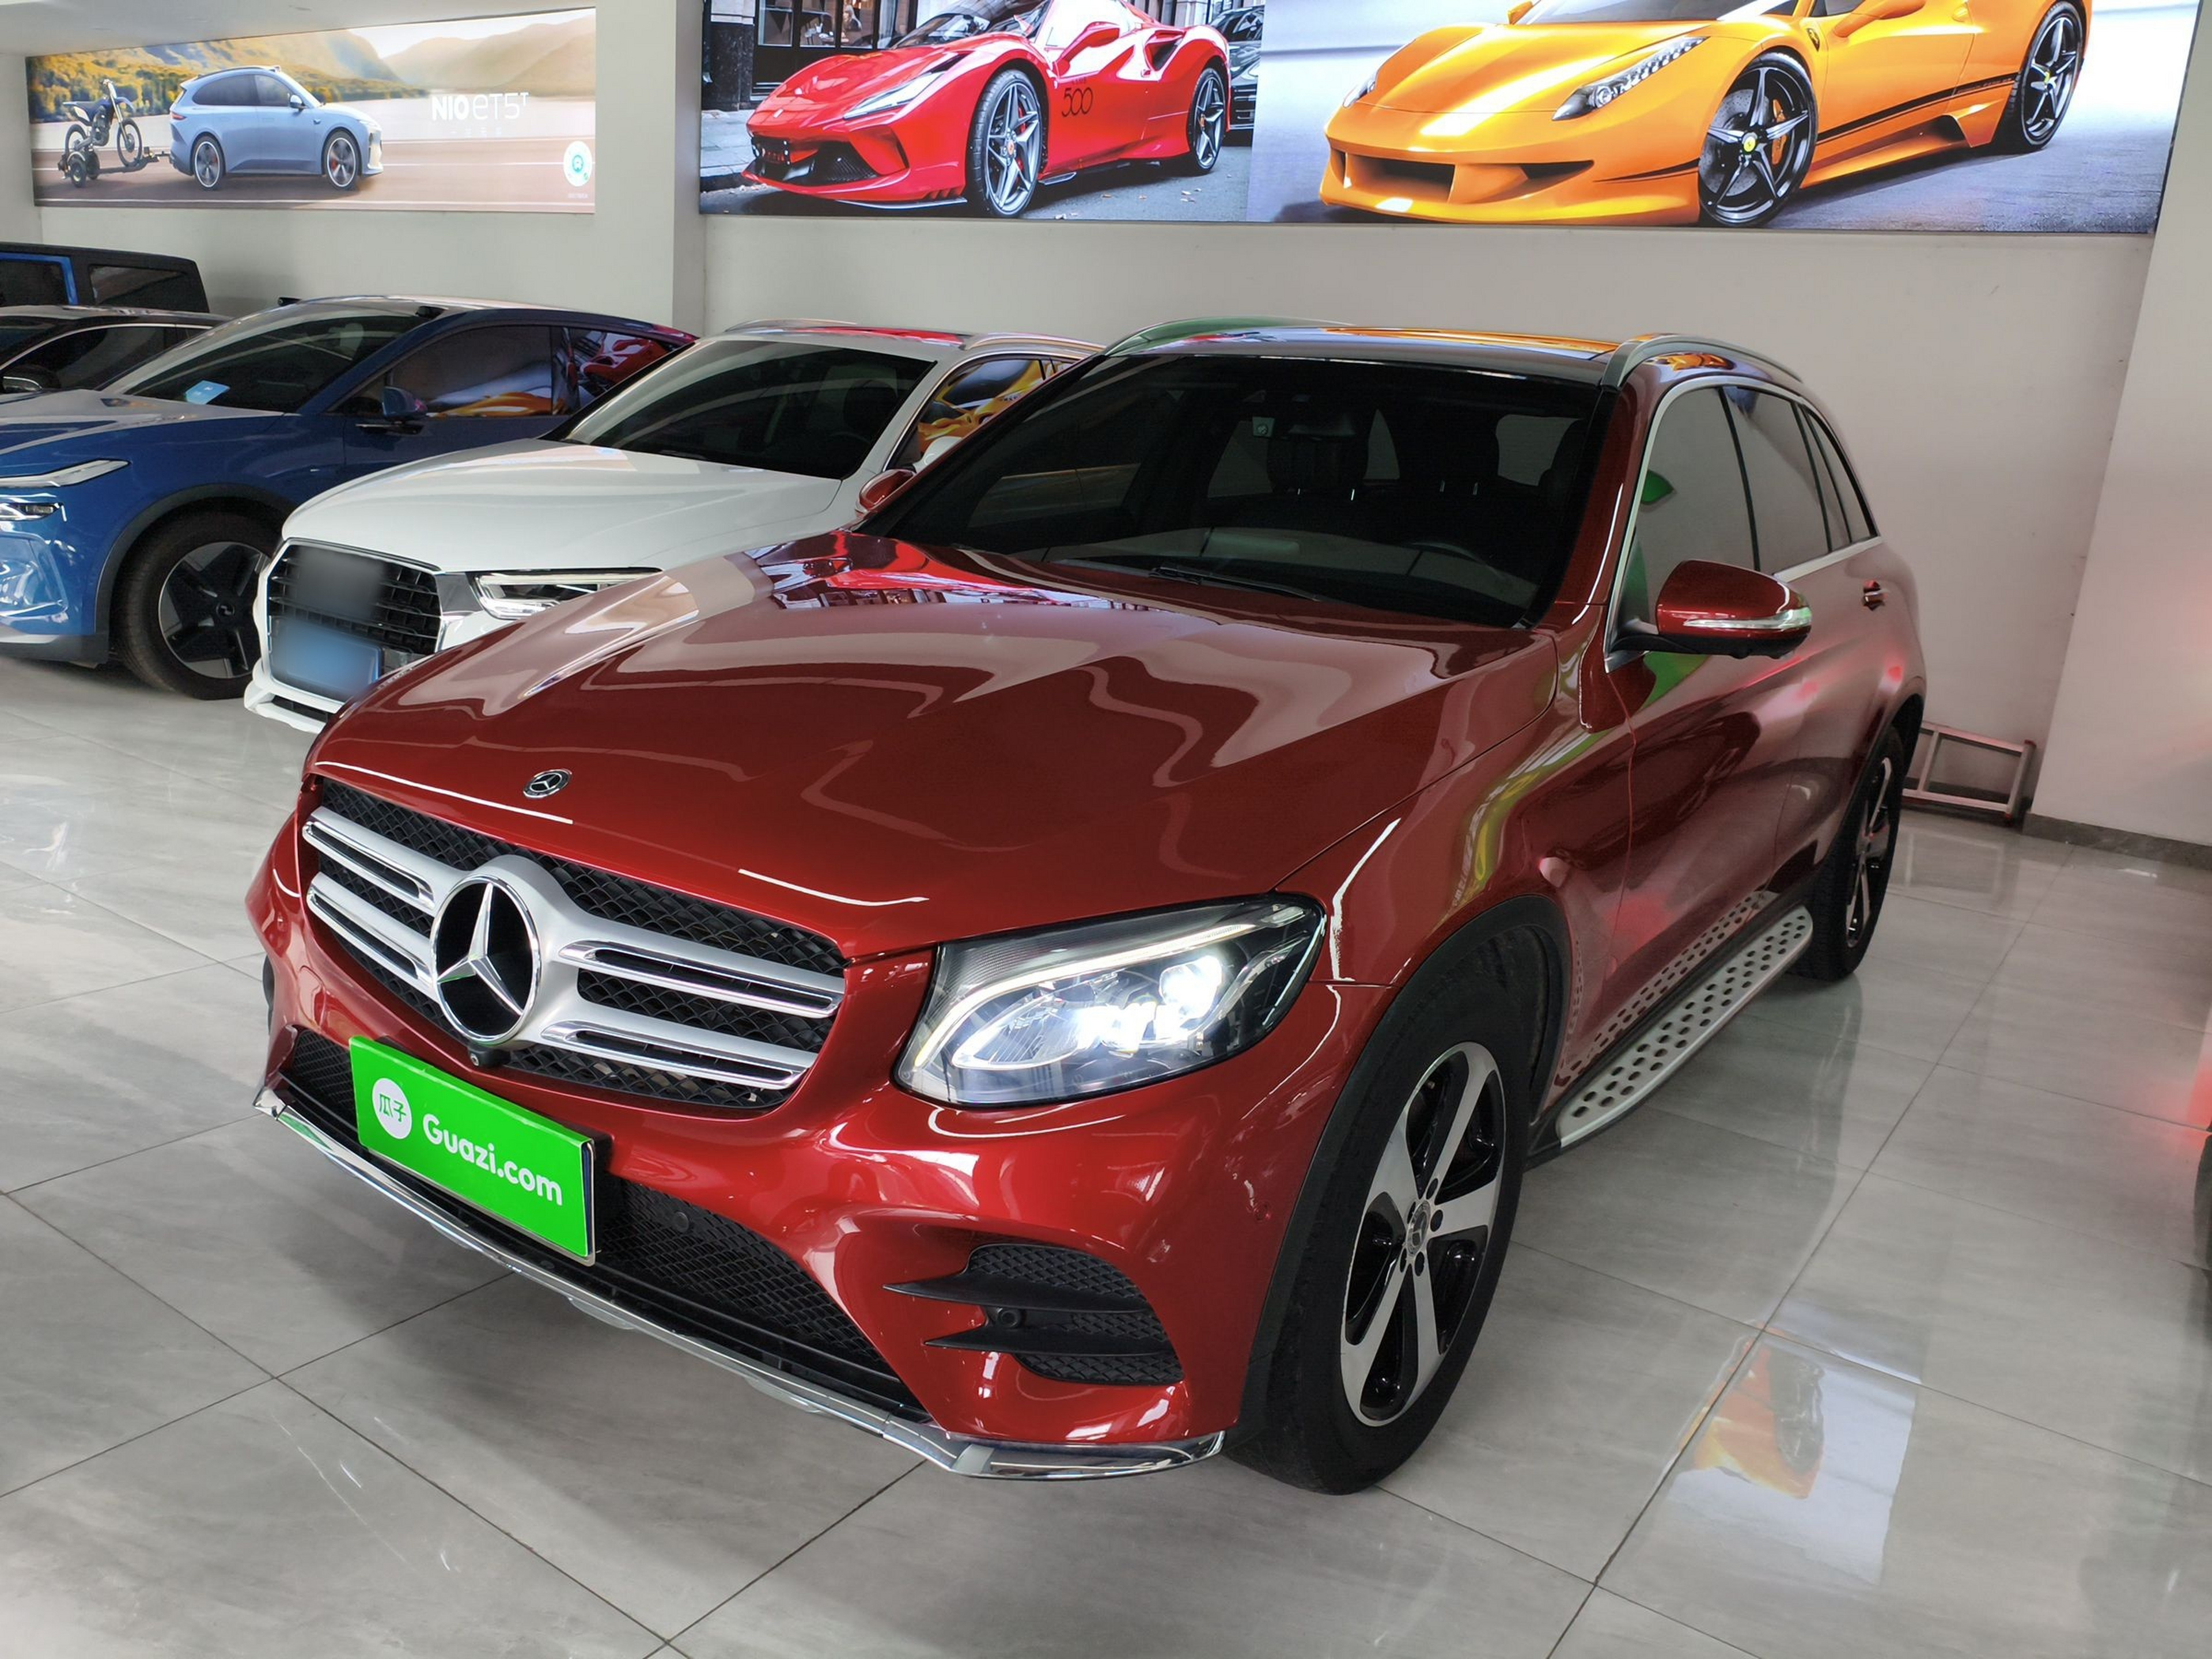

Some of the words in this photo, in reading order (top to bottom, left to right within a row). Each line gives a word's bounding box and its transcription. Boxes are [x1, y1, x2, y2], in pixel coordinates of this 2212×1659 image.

[431, 94, 469, 120] NIO
[1062, 87, 1093, 118] 500
[379, 1093, 407, 1122] 瓜子
[423, 1113, 563, 1206] Guazi.com
